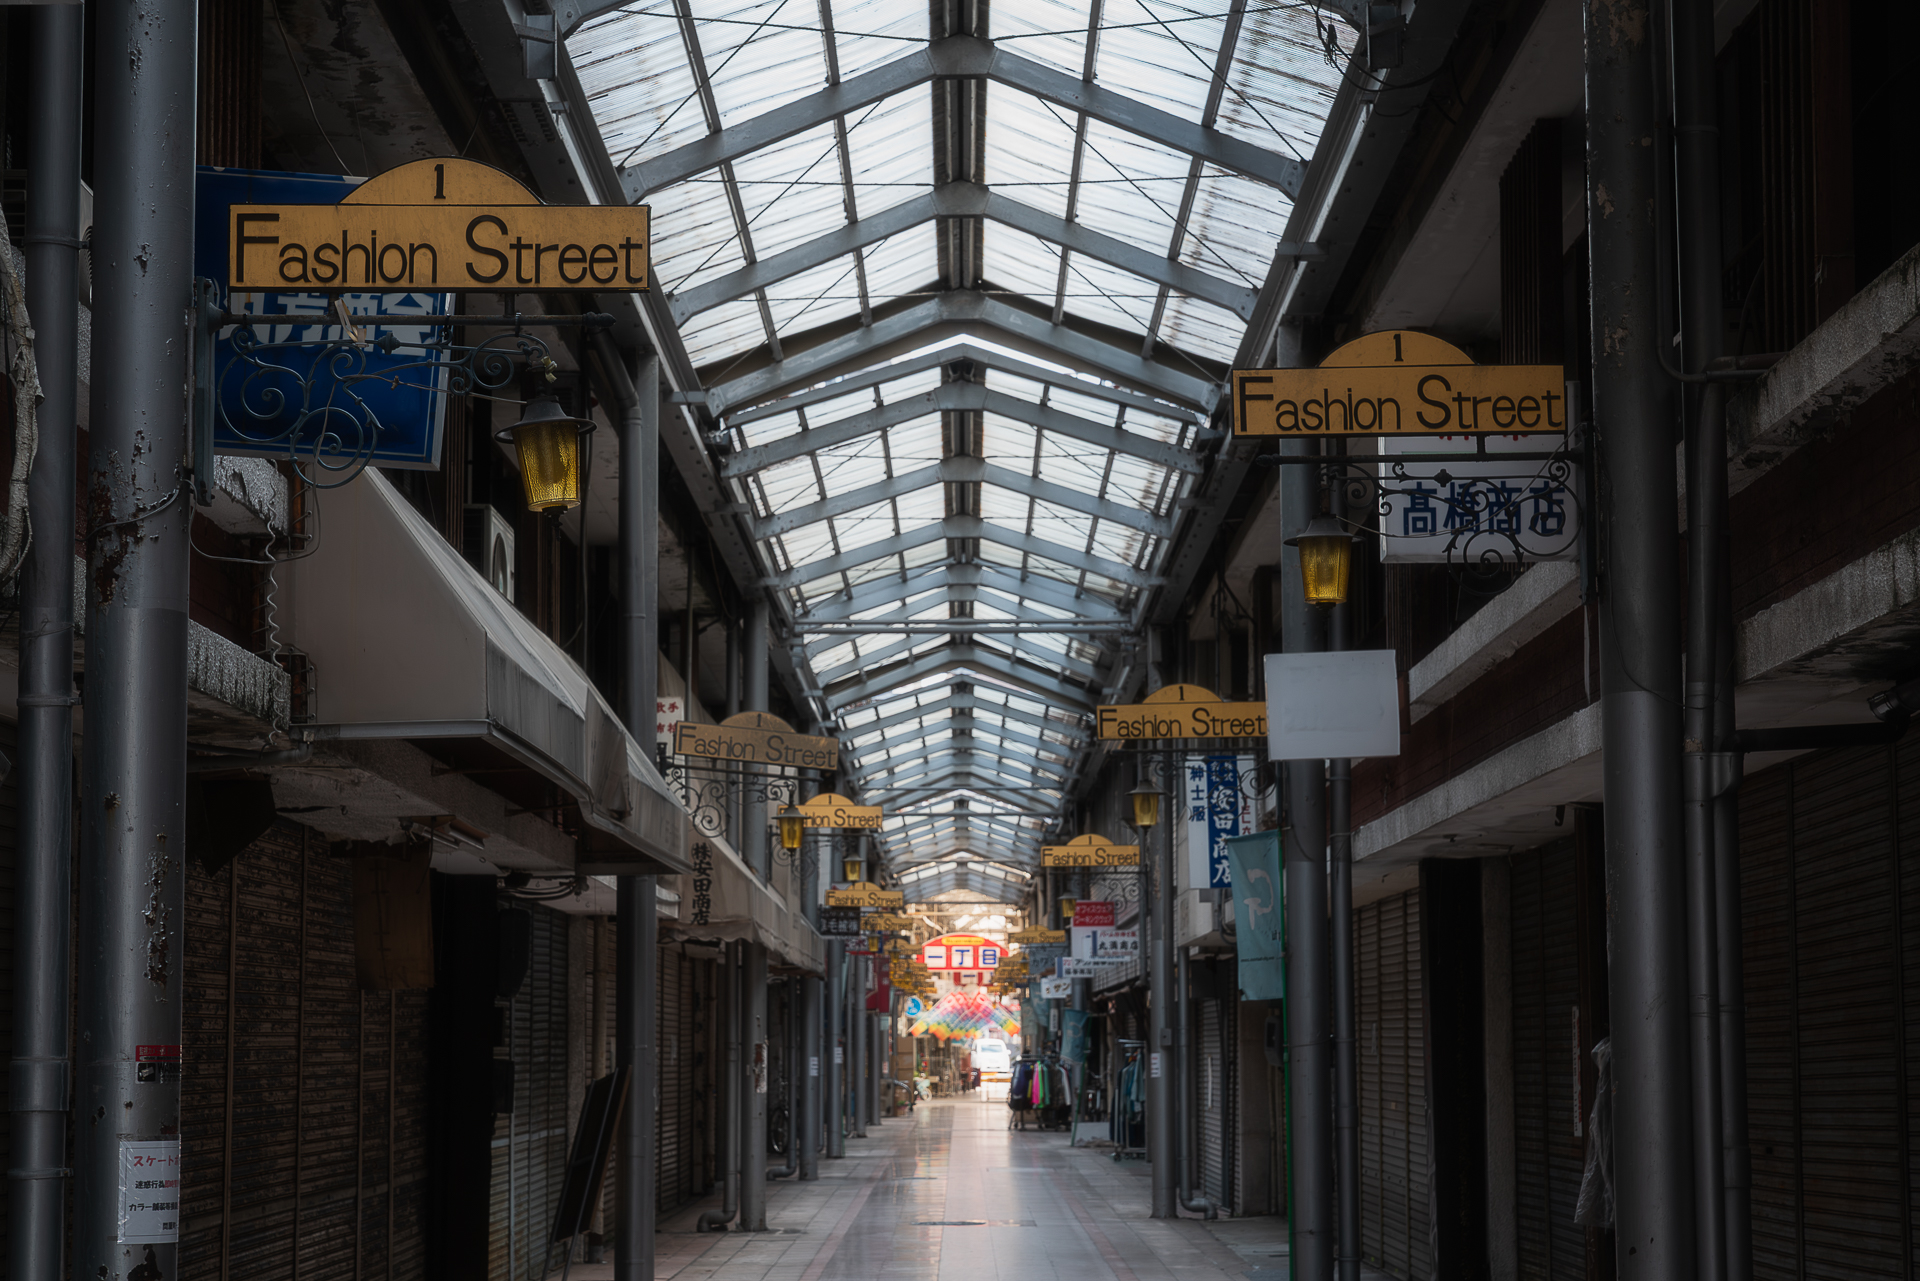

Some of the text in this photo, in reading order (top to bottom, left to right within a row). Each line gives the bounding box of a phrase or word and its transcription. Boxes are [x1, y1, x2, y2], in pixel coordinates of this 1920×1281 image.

[433, 163, 445, 199] 1
[235, 213, 644, 284] Fashion Street
[1393, 333, 1404, 363] 1
[1238, 374, 1563, 434] Fashion Street
[1179, 685, 1185, 701] 1
[1099, 706, 1266, 738] Fashion Street
[677, 725, 837, 768] Fashion Street
[1190, 765, 1206, 822] 紳士服
[834, 807, 882, 828] Street
[1042, 848, 1138, 865] Fashion Street
[827, 892, 902, 906] Fashion Street
[928, 949, 997, 965] 一丁目
